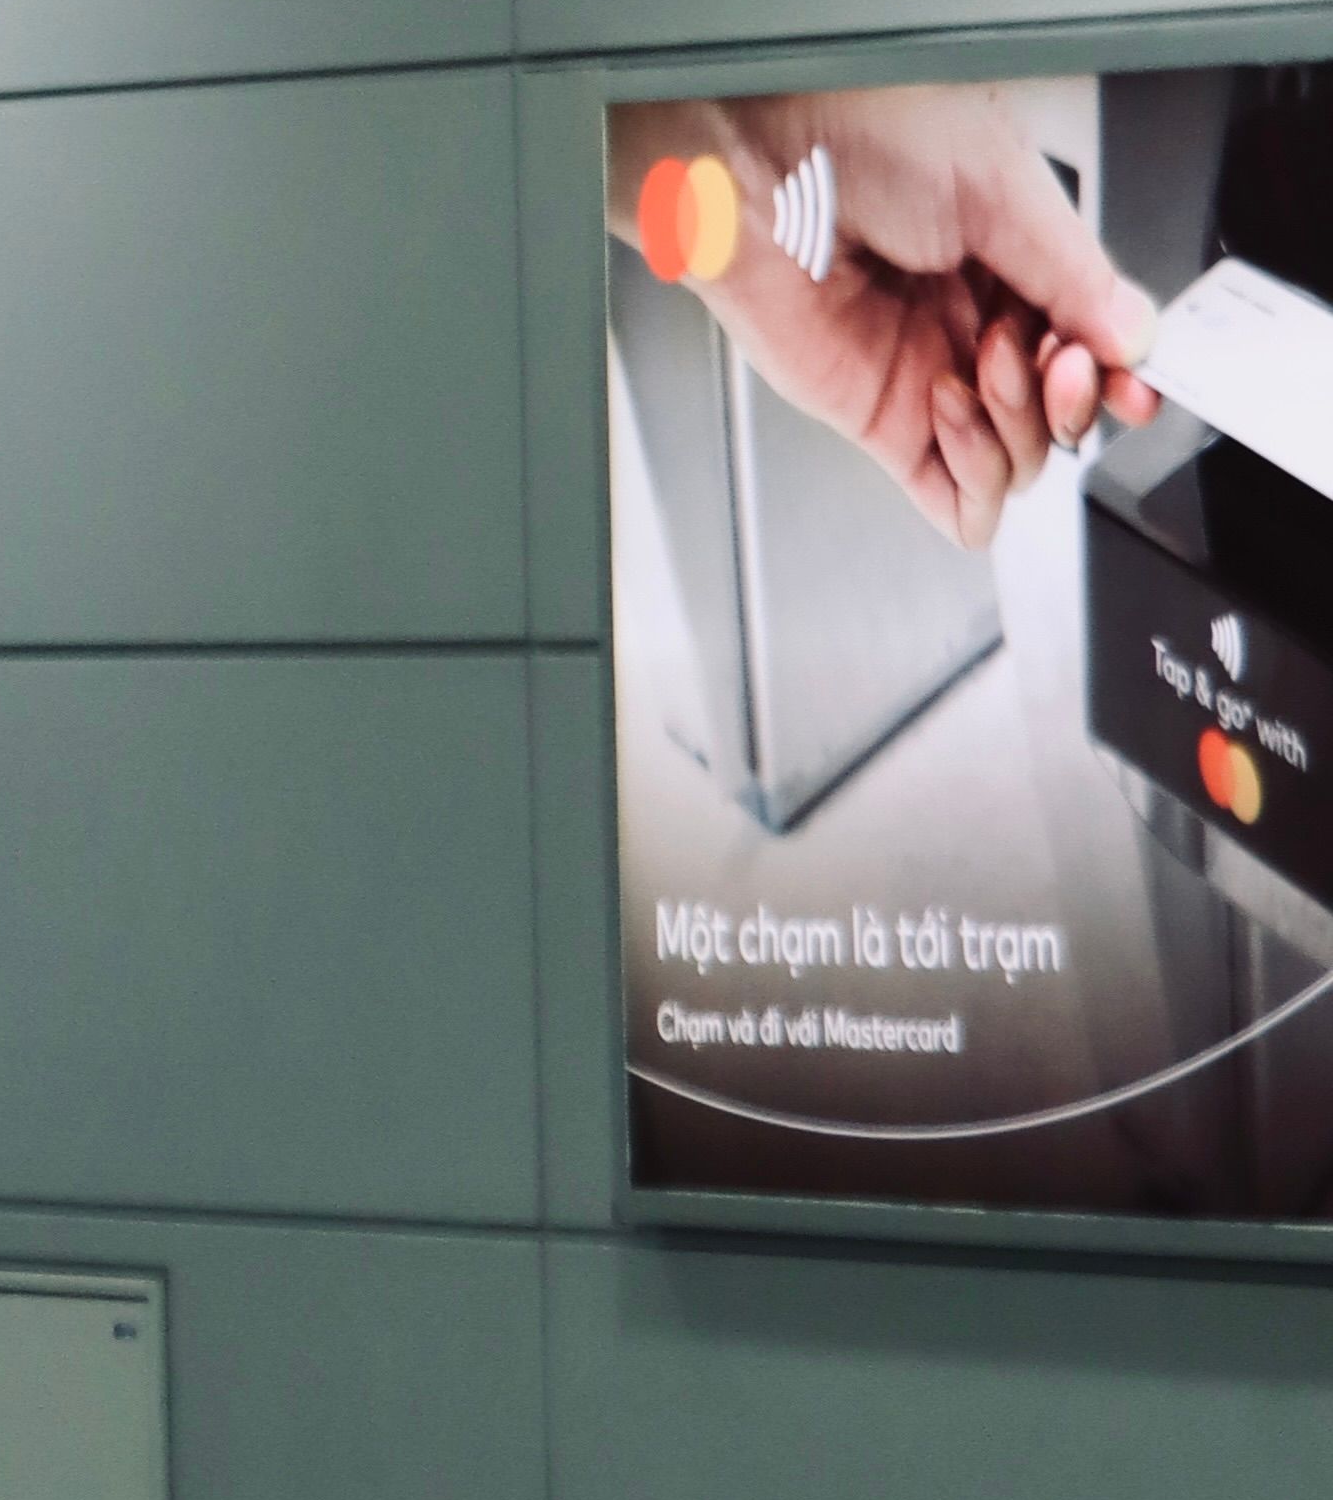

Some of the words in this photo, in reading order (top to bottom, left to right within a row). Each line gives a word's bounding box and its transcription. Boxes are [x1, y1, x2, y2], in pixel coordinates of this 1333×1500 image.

[1150, 633, 1193, 700] Tap
[1194, 665, 1214, 712] &
[1254, 715, 1309, 774] with
[655, 898, 731, 977] Một
[736, 900, 844, 980] chạm
[851, 904, 889, 968] là
[896, 904, 951, 970] tới
[959, 912, 1062, 986] trạm
[656, 1000, 725, 1051] Chạm
[726, 1006, 757, 1047] và
[758, 1004, 783, 1048] đi
[784, 1005, 821, 1049] với
[822, 1005, 965, 1055] Mastercard
